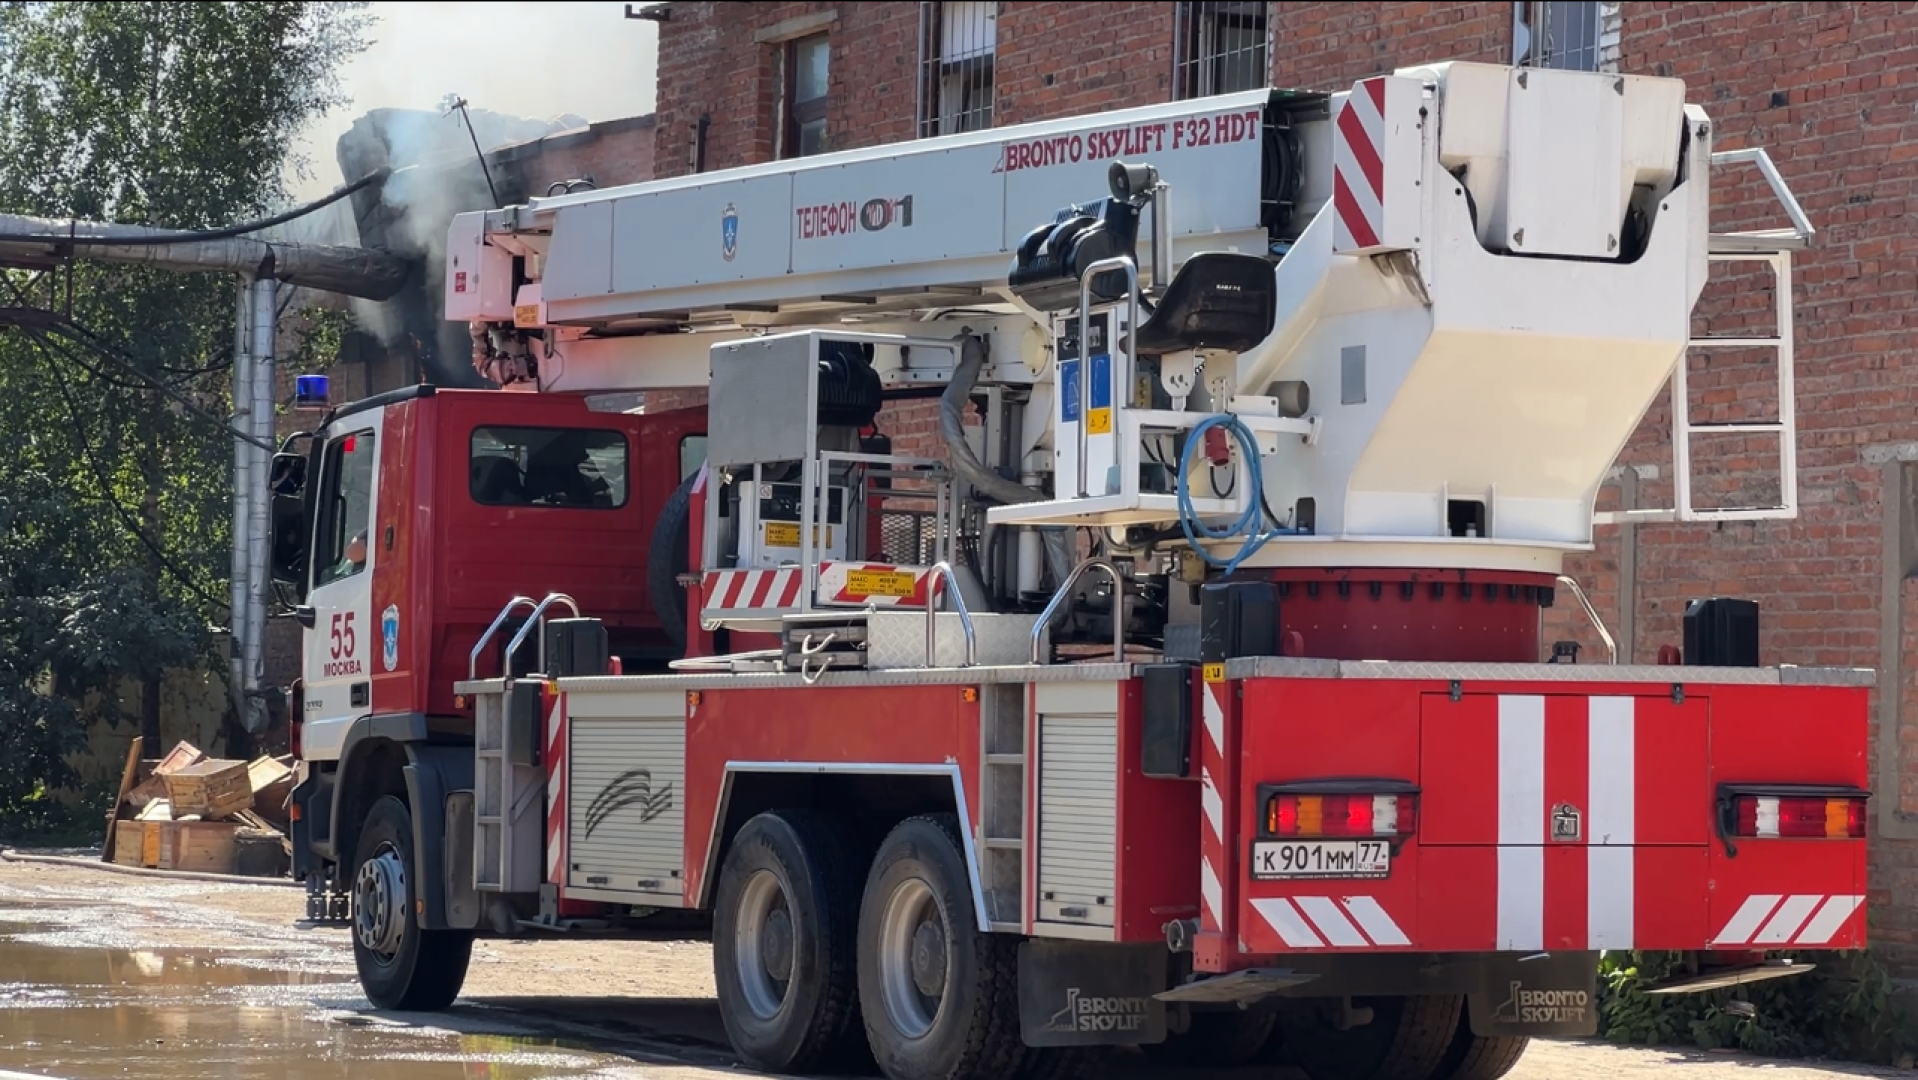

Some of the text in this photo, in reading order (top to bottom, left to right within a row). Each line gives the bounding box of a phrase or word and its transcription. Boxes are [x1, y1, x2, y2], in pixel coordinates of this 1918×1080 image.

[1006, 135, 1083, 171] BRONTO
[1087, 123, 1166, 160] SKYLIFT
[1214, 111, 1259, 143] HDT
[796, 201, 857, 239] ТЕЛЕФОН
[330, 611, 355, 660] 55
[324, 660, 362, 677] МОСКВА
[1360, 843, 1382, 863] 77
[1520, 990, 1588, 1006] BRONTO
[1521, 1007, 1586, 1022] SKYLIFT
